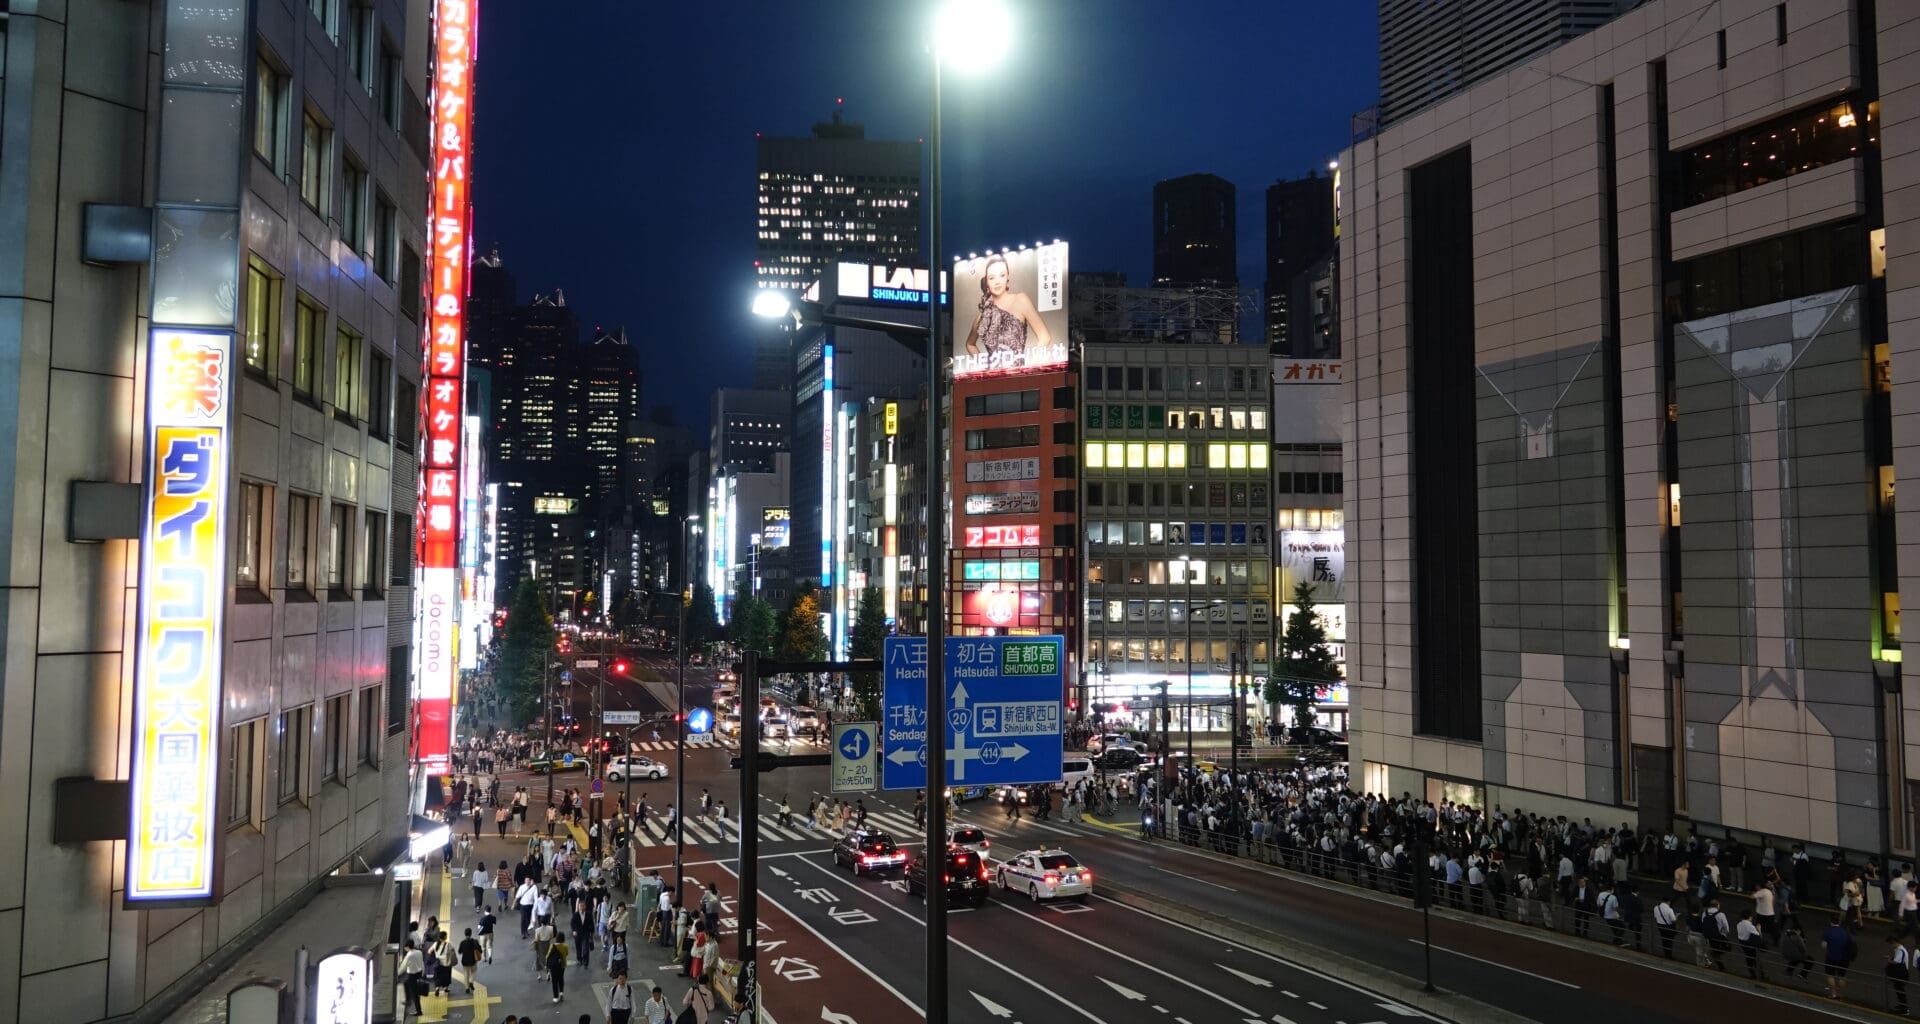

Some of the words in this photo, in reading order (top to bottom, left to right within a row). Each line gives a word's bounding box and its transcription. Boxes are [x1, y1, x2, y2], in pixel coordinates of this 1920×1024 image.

[873, 288, 920, 302] SHINJUKU
[986, 462, 1020, 471] 新宿駅前
[968, 527, 1018, 544] アコム
[156, 437, 214, 687] ダイコク
[428, 593, 442, 673] docomo
[957, 642, 996, 663] 初台
[1005, 646, 1055, 662] 首都高
[896, 667, 928, 679] Hachi
[954, 666, 998, 678] Hatsudai
[1004, 664, 1039, 674] SHUTOKO
[1041, 663, 1055, 673] EXP
[889, 705, 928, 726] 千駄ケ
[953, 712, 967, 725] 20
[1004, 705, 1057, 722] 新宿駅西口
[889, 729, 928, 741] Sendag
[1004, 723, 1034, 734] Shinjuku
[982, 748, 999, 759] 414
[841, 765, 868, 775] 7-20
